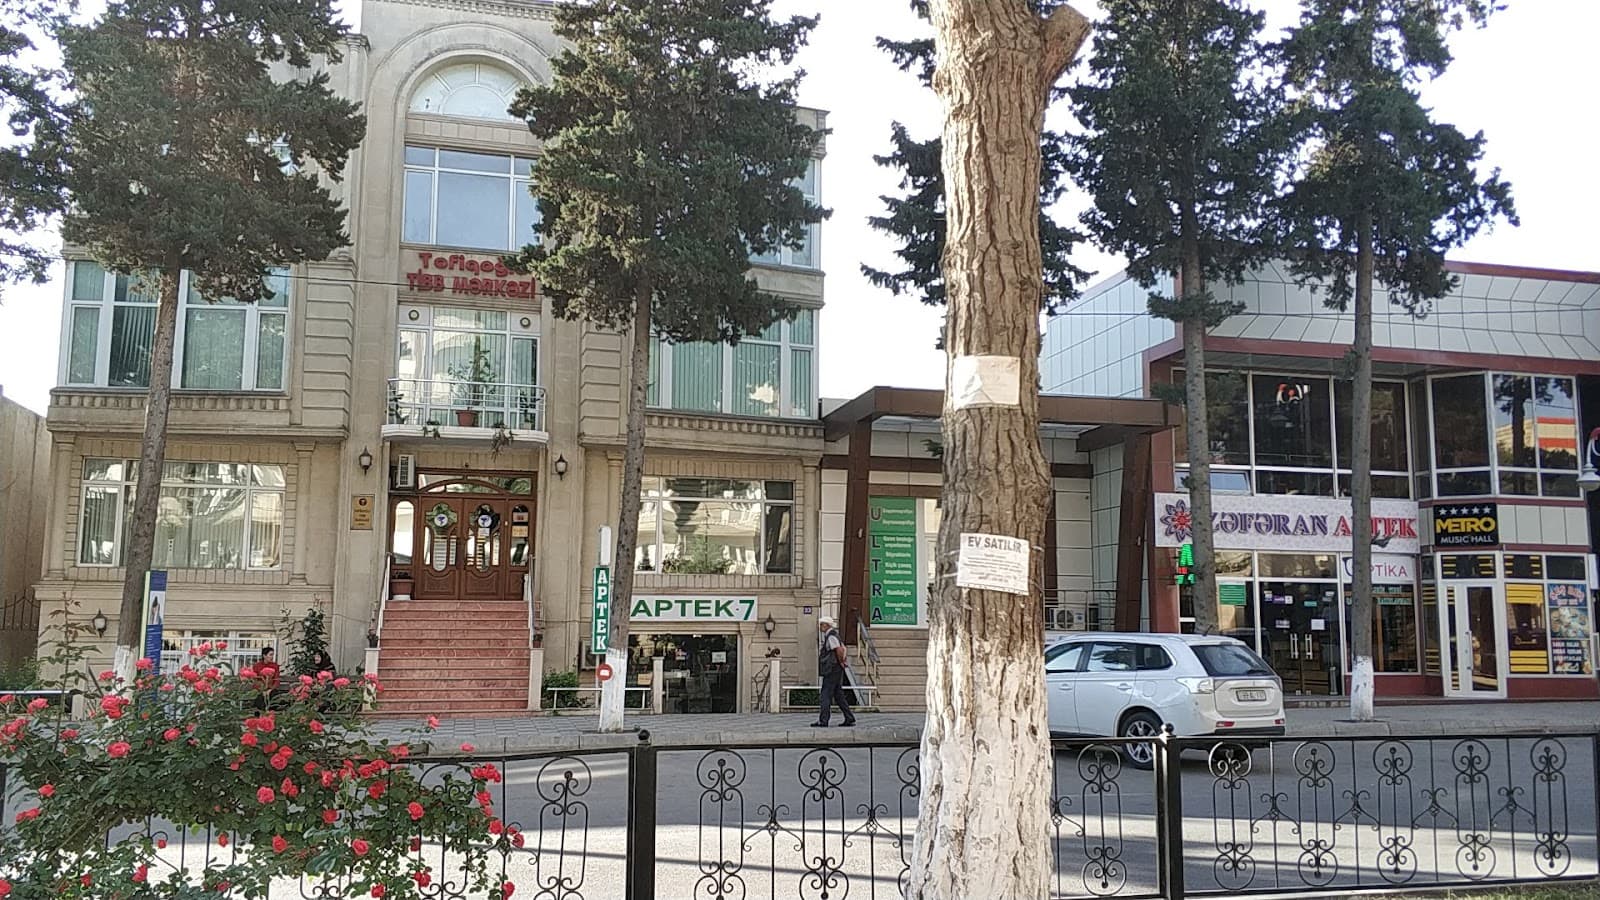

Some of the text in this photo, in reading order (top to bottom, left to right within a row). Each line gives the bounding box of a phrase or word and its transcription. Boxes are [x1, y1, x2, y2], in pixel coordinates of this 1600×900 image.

[406, 268, 444, 292] TİBB
[1333, 515, 1418, 539] ATEK
[1435, 516, 1496, 534] METRO
[967, 535, 1022, 554] EV SATILIR
[1440, 535, 1493, 544] MUSIC HALL
[596, 569, 609, 650] APTEK
